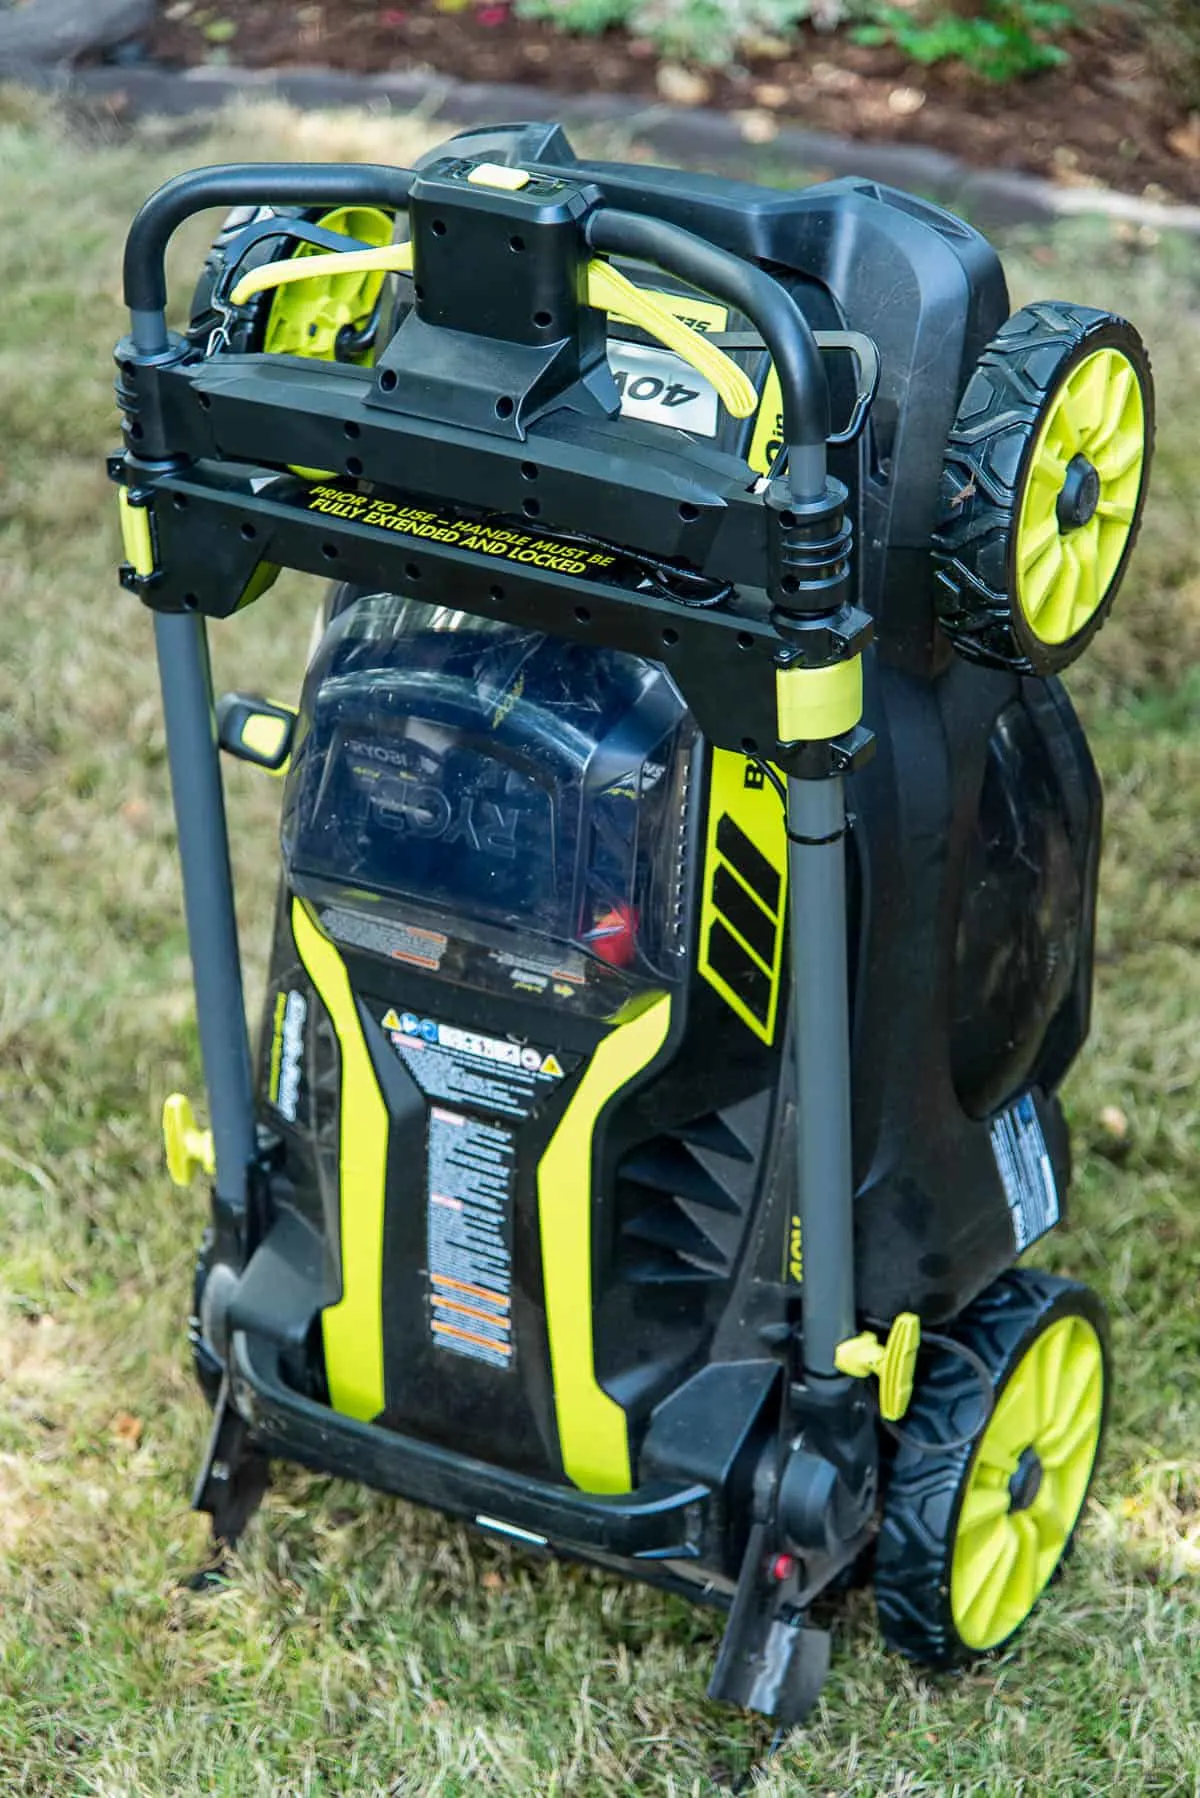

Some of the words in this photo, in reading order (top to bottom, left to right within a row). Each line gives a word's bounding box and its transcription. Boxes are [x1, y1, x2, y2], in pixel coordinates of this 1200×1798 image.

[308, 499, 367, 519] FULLY
[362, 511, 460, 542] EXTENDED
[458, 536, 508, 554] AND
[507, 547, 587, 574] LOCKED
[309, 486, 368, 506] PRIOR
[368, 500, 397, 512] TO
[397, 507, 438, 523] USE
[451, 521, 532, 545] HANDLE
[529, 540, 589, 559] MUST
[586, 553, 616, 567] BE
